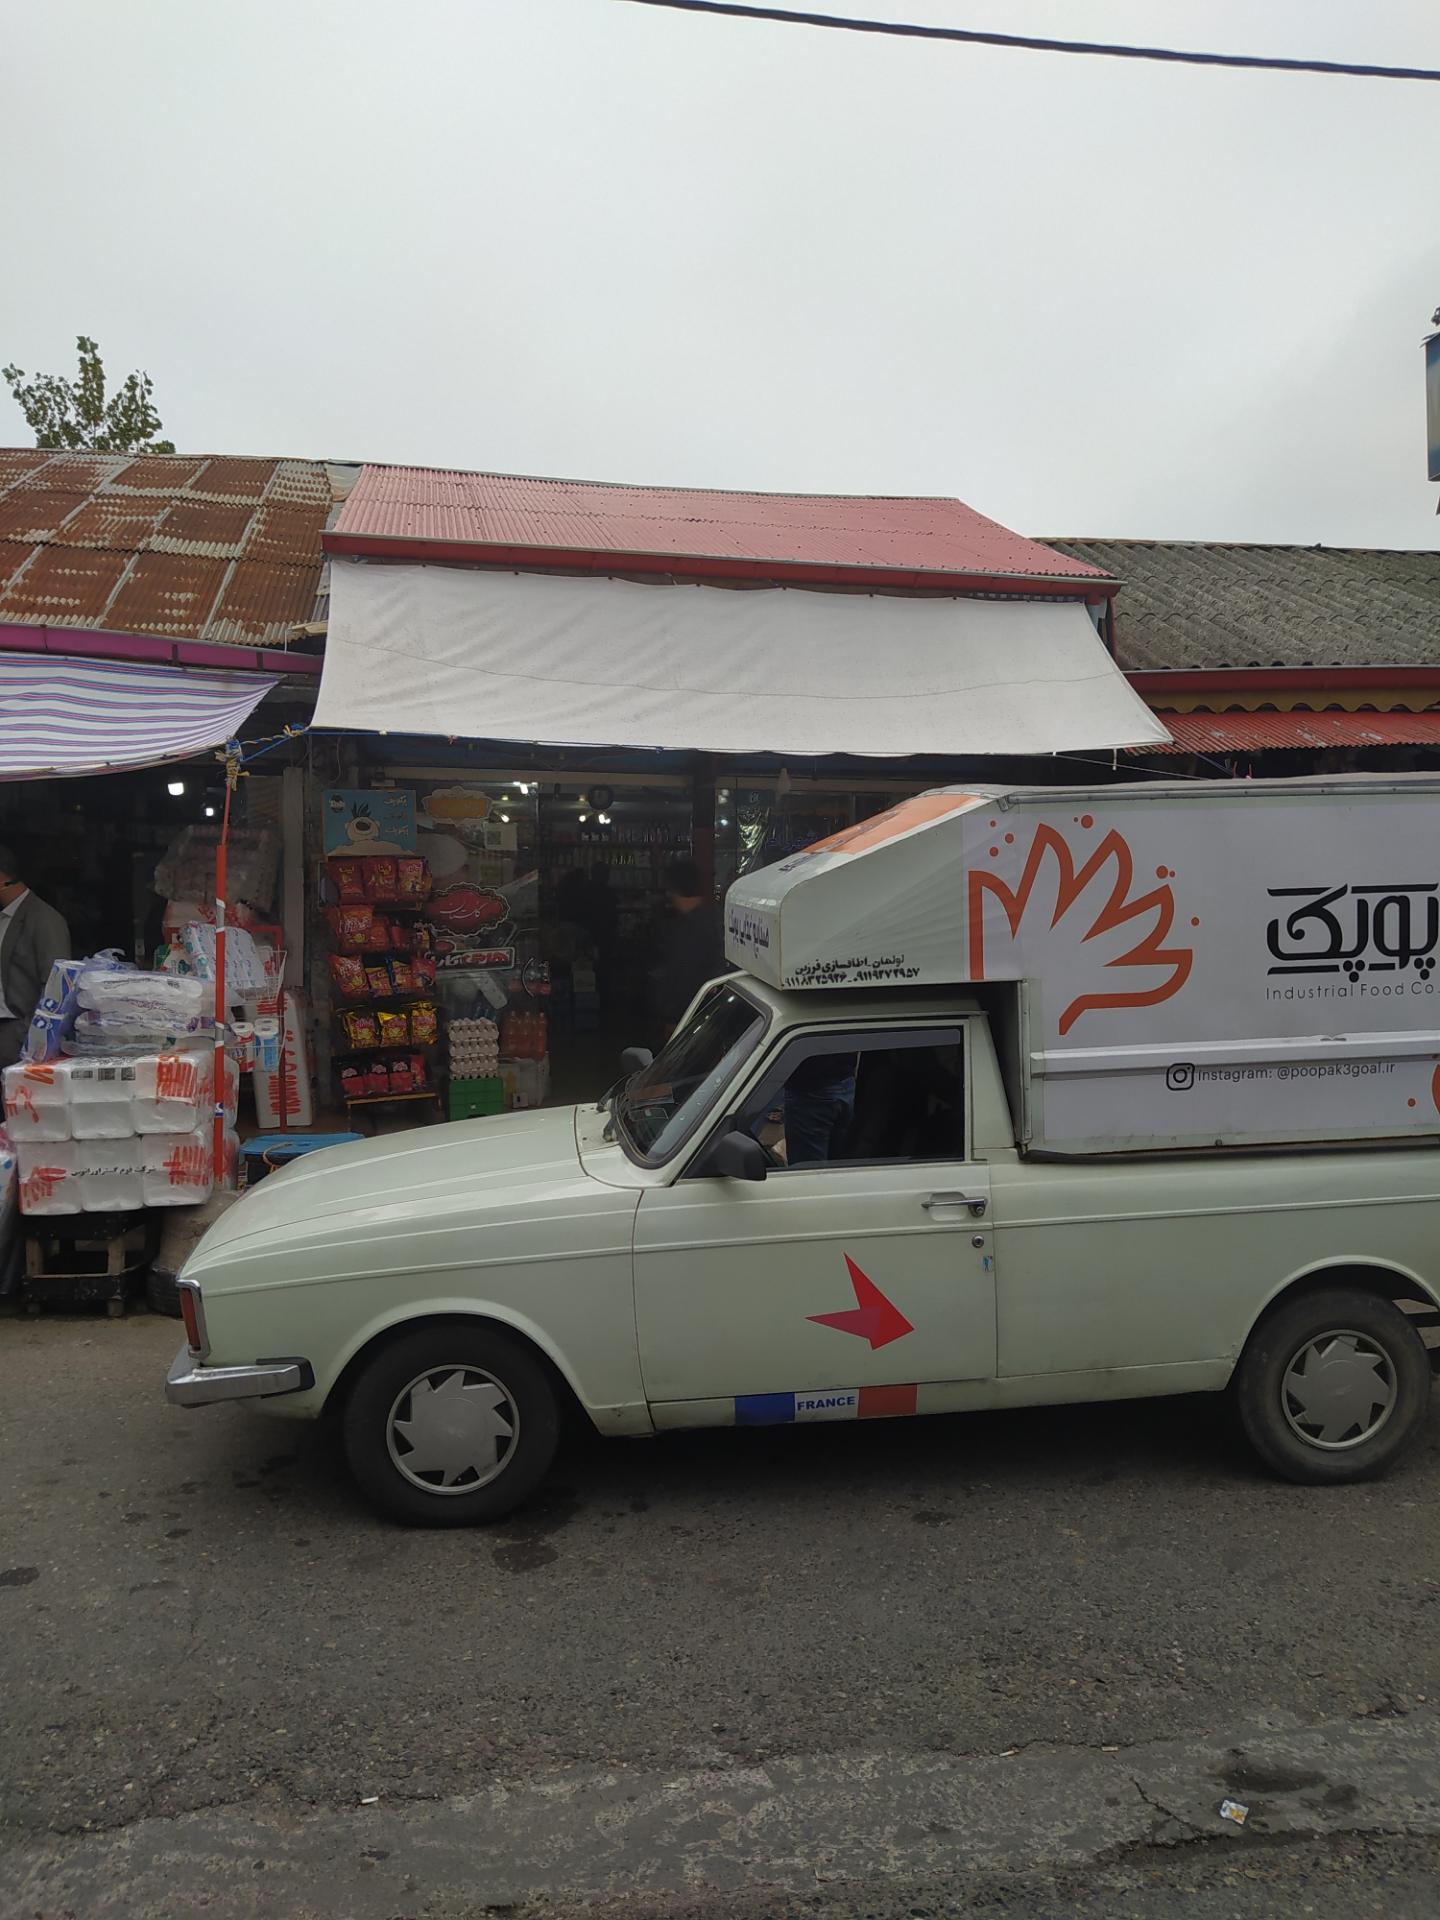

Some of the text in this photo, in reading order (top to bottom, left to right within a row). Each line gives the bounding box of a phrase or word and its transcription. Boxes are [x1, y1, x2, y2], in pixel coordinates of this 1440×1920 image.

[1266, 883, 1439, 983] پوپک
[1266, 985, 1354, 1000] Industrial
[1360, 983, 1404, 997] Food
[1198, 1061, 1396, 1083] Instagram: @poopak3goal.ir
[797, 1396, 855, 1411] FRANCE
